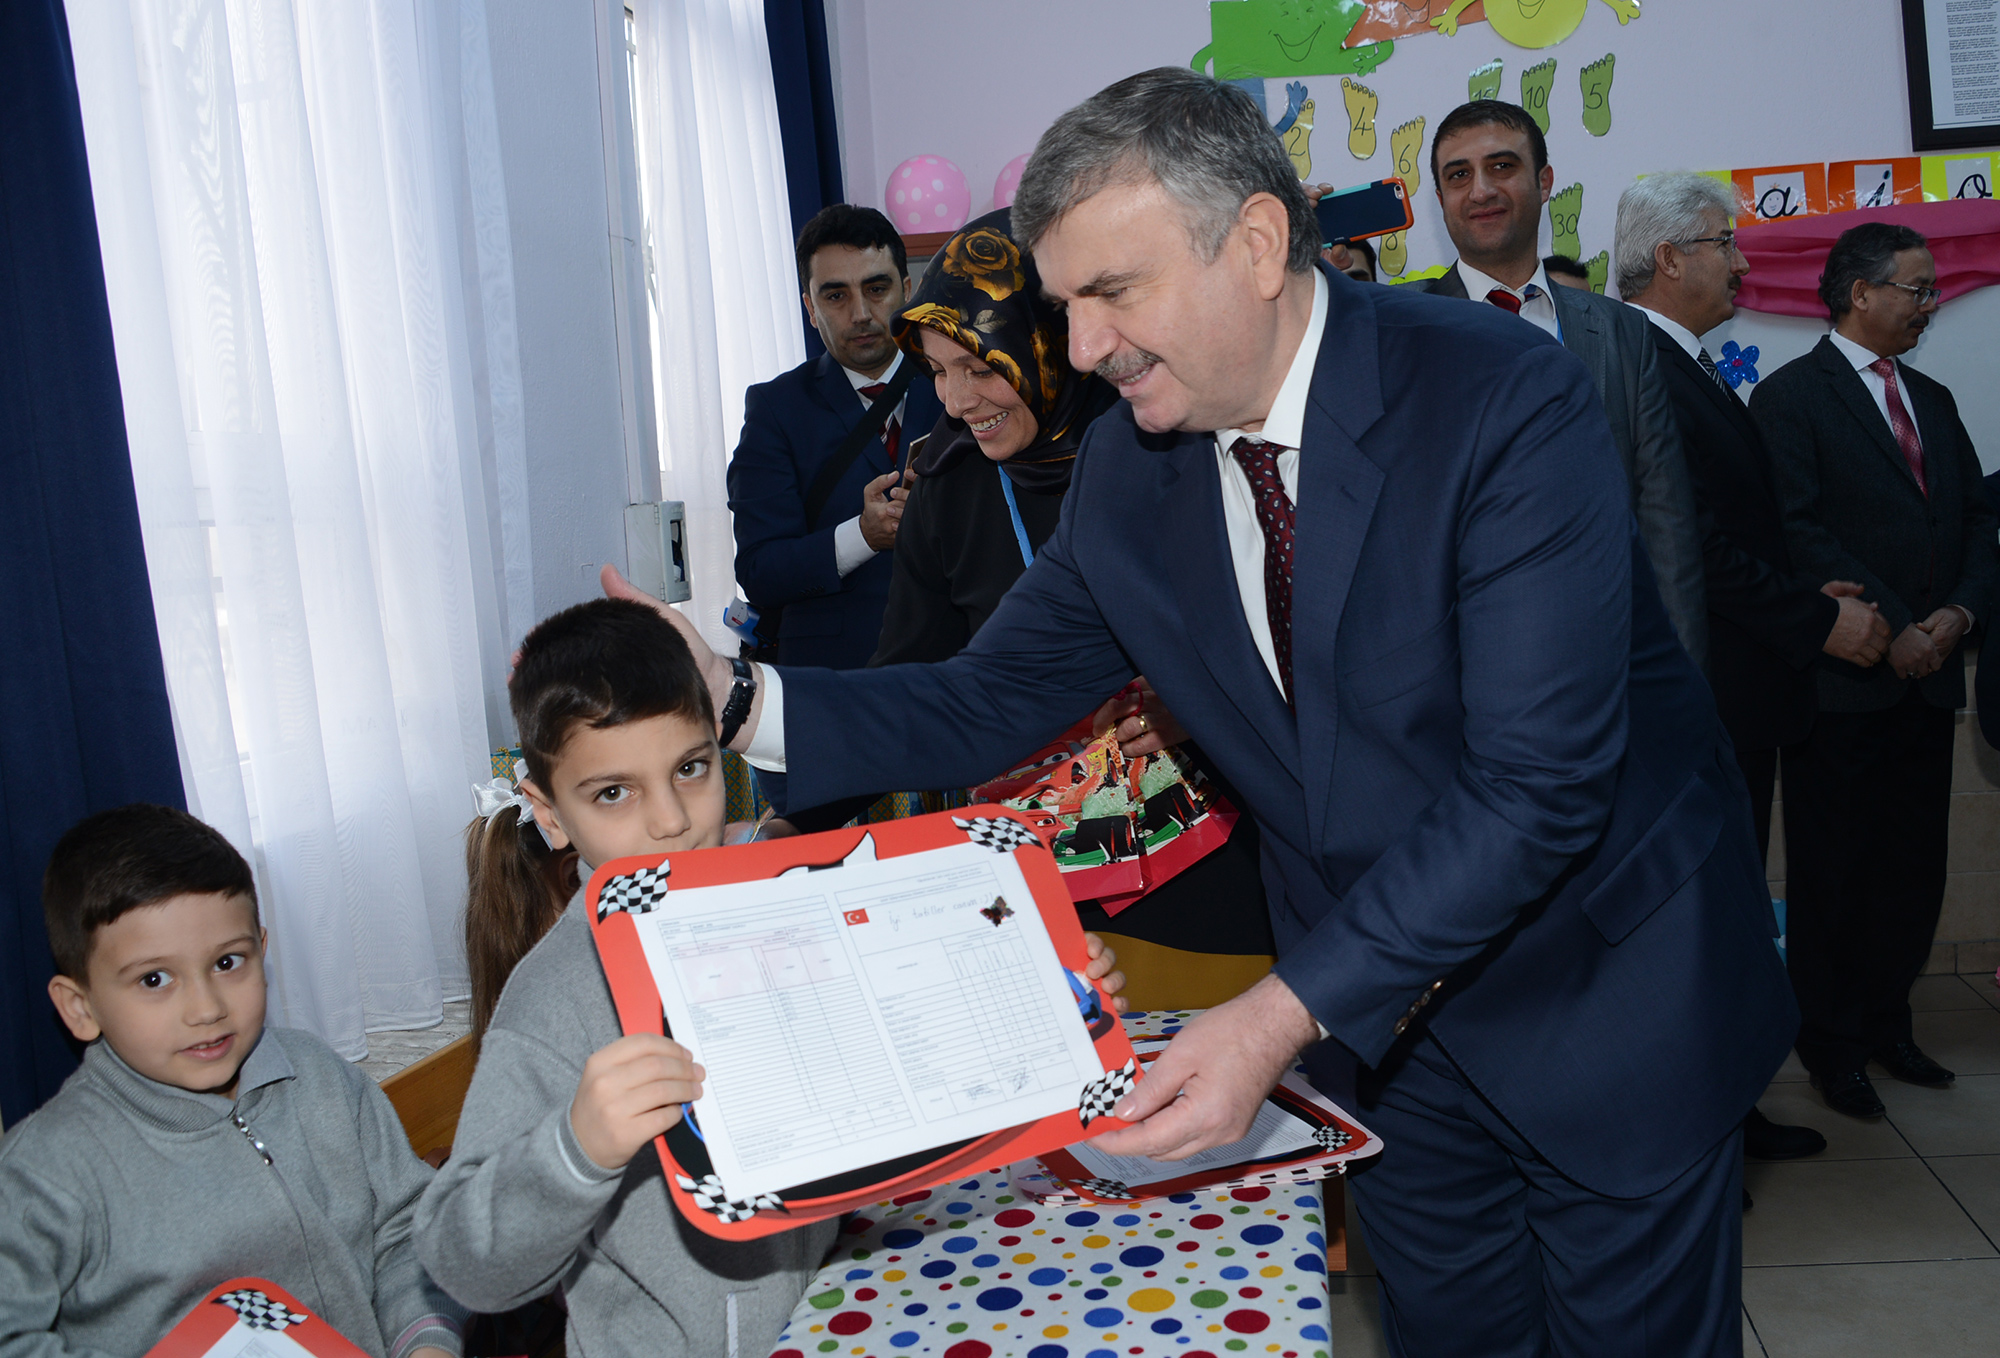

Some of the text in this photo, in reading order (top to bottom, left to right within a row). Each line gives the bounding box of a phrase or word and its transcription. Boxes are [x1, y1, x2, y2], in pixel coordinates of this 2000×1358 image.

[1526, 85, 1545, 110] 10
[1585, 82, 1603, 110] 5
[1353, 106, 1373, 136] 4
[1288, 126, 1307, 157] 2
[1398, 143, 1411, 174] 6
[1755, 186, 1800, 219] a
[1554, 213, 1578, 237] 30
